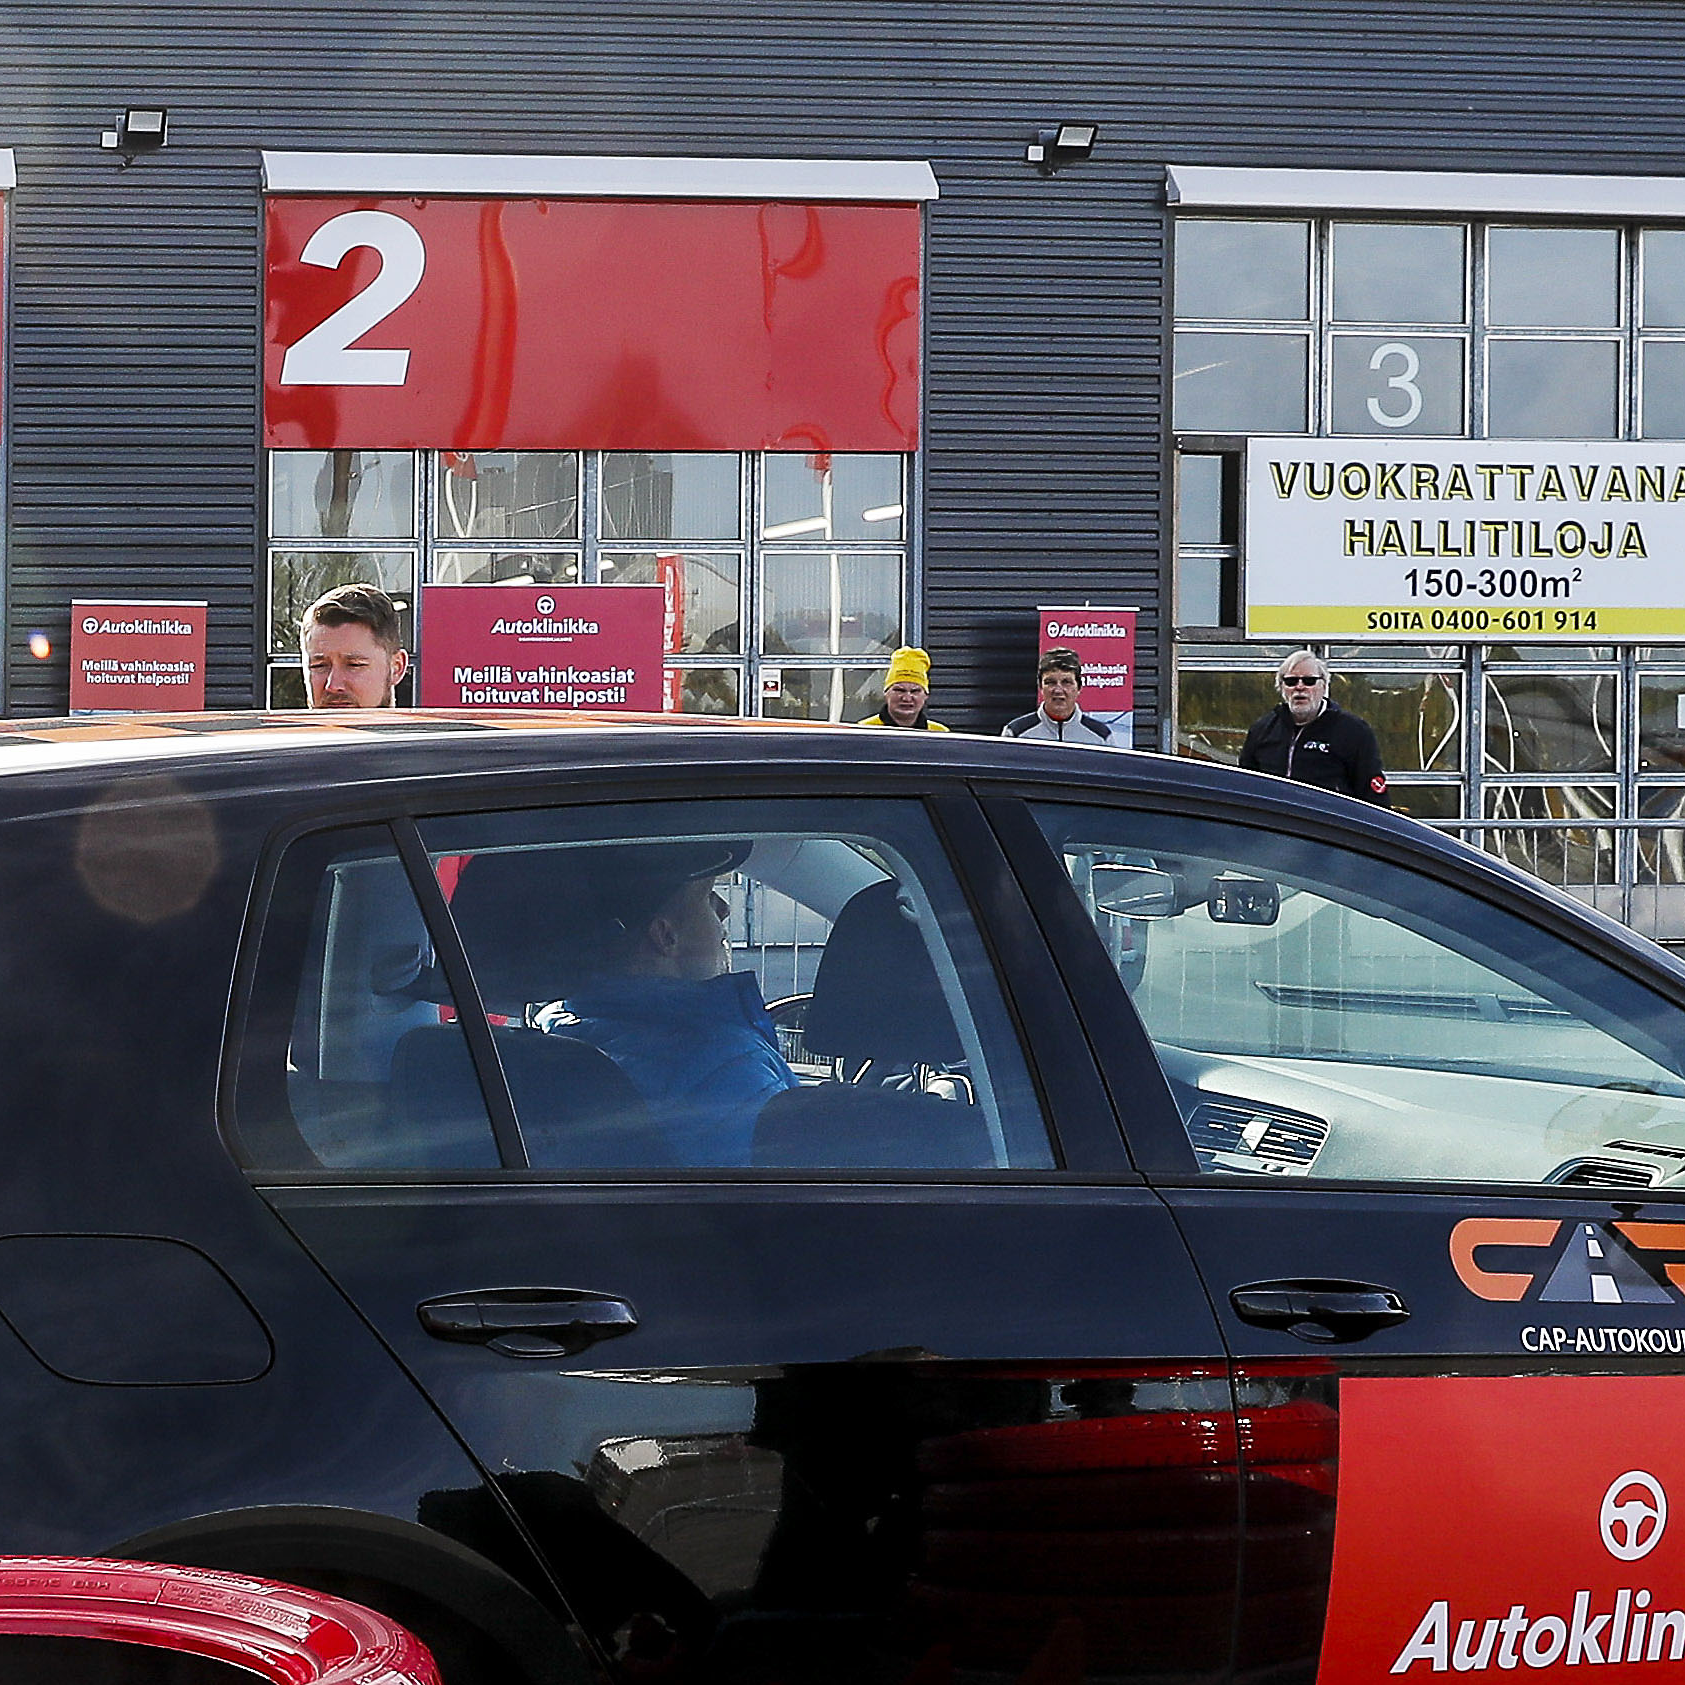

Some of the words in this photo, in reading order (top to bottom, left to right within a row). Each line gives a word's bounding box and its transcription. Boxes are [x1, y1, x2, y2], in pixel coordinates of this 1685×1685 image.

[279, 210, 426, 386] 2
[1366, 342, 1423, 428] 3
[1342, 519, 1648, 559] HALLITILOJA
[1403, 566, 1583, 599] 150-300m²
[98, 619, 193, 635] Autoklinikka
[490, 618, 600, 635] Autoklinikka
[1058, 623, 1127, 638] Autoklinikka
[1367, 611, 1424, 631] SOITA
[1430, 610, 1546, 631] 0400-601
[1554, 612, 1598, 631] 914
[81, 659, 119, 671] Meillä
[120, 660, 196, 673] vahinkoasiat
[453, 665, 513, 684] Meillä
[515, 666, 635, 685] vahinkoasiat
[86, 671, 136, 684] hoituvat
[137, 672, 190, 687] helposti!
[461, 686, 541, 704] hoituvat
[543, 686, 627, 708] helposti!
